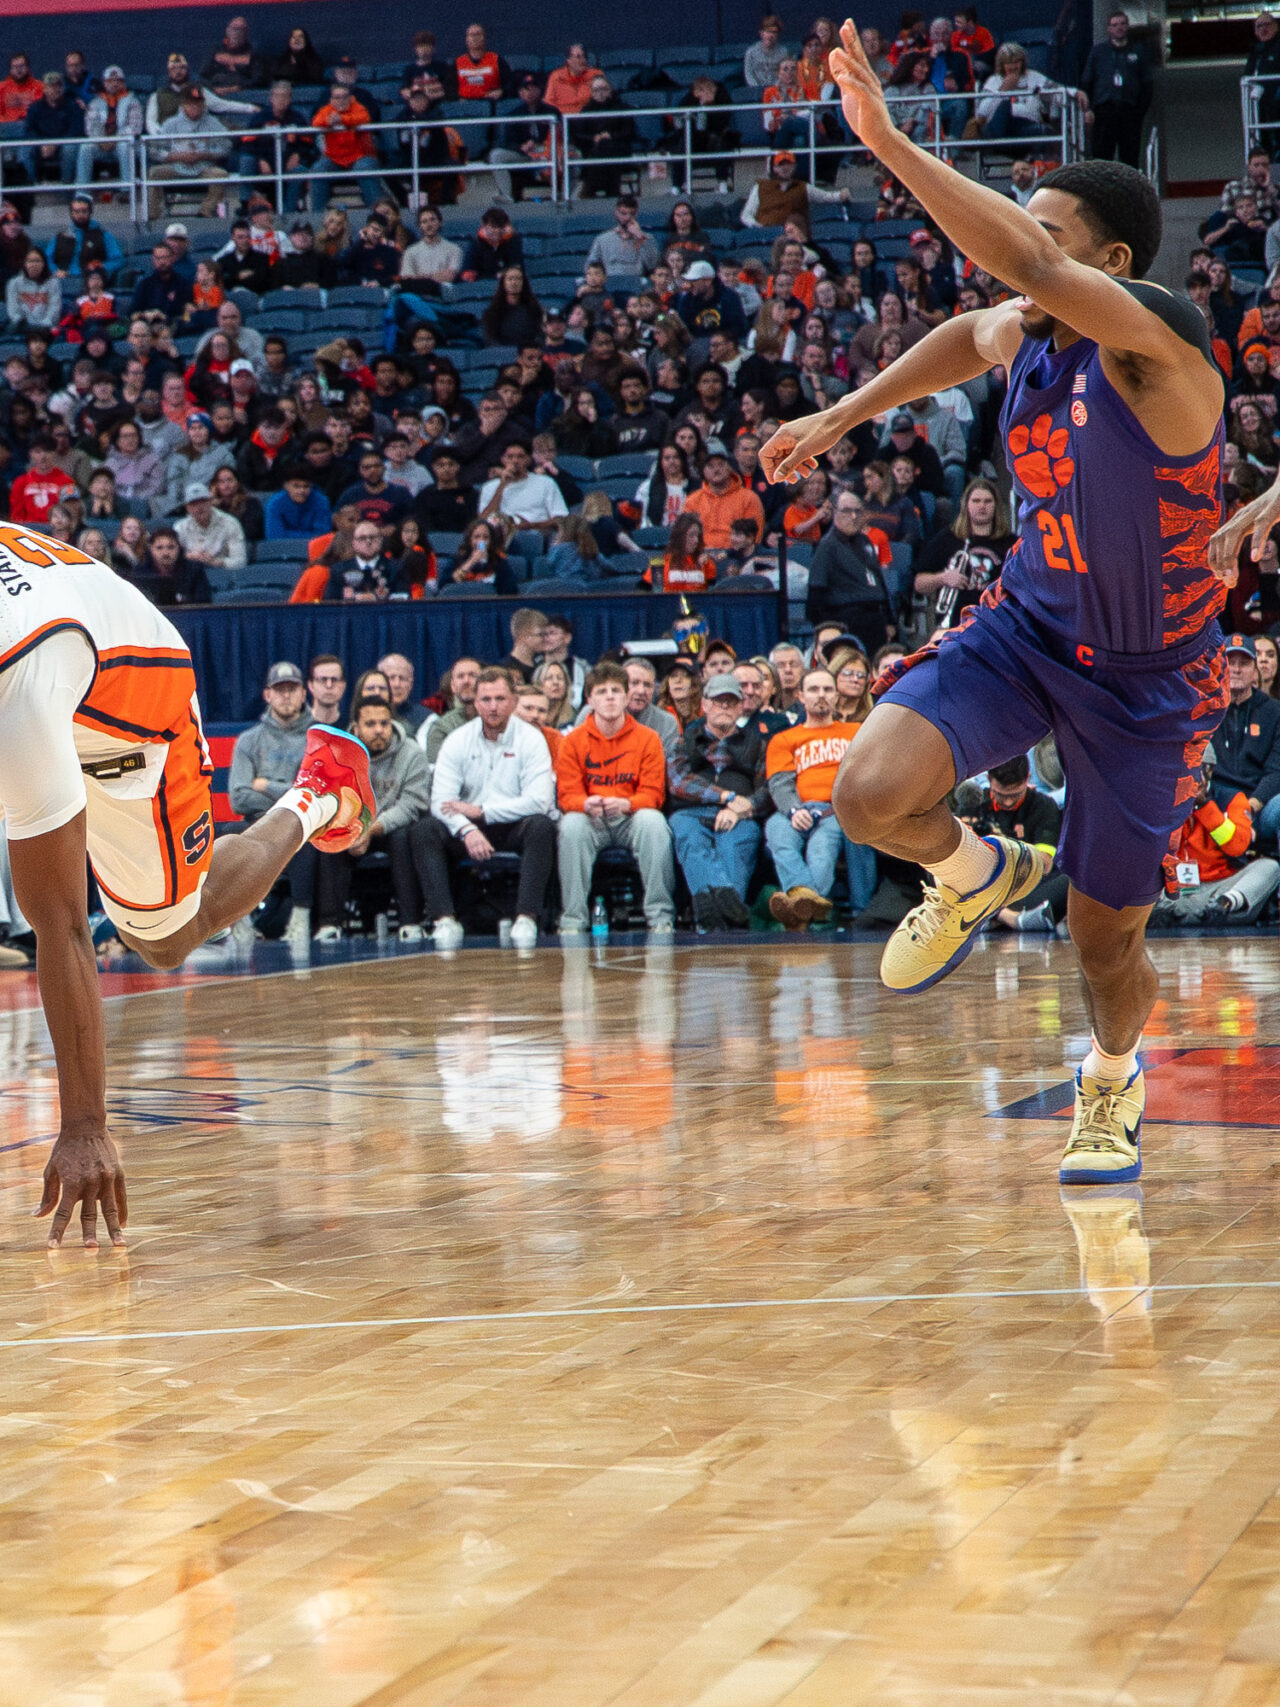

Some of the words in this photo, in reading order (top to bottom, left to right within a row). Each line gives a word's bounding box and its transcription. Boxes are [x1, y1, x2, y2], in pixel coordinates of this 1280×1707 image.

[1036, 509, 1088, 573] 21
[1076, 644, 1094, 666] C
[123, 760, 135, 768] 46
[182, 810, 211, 866] S
